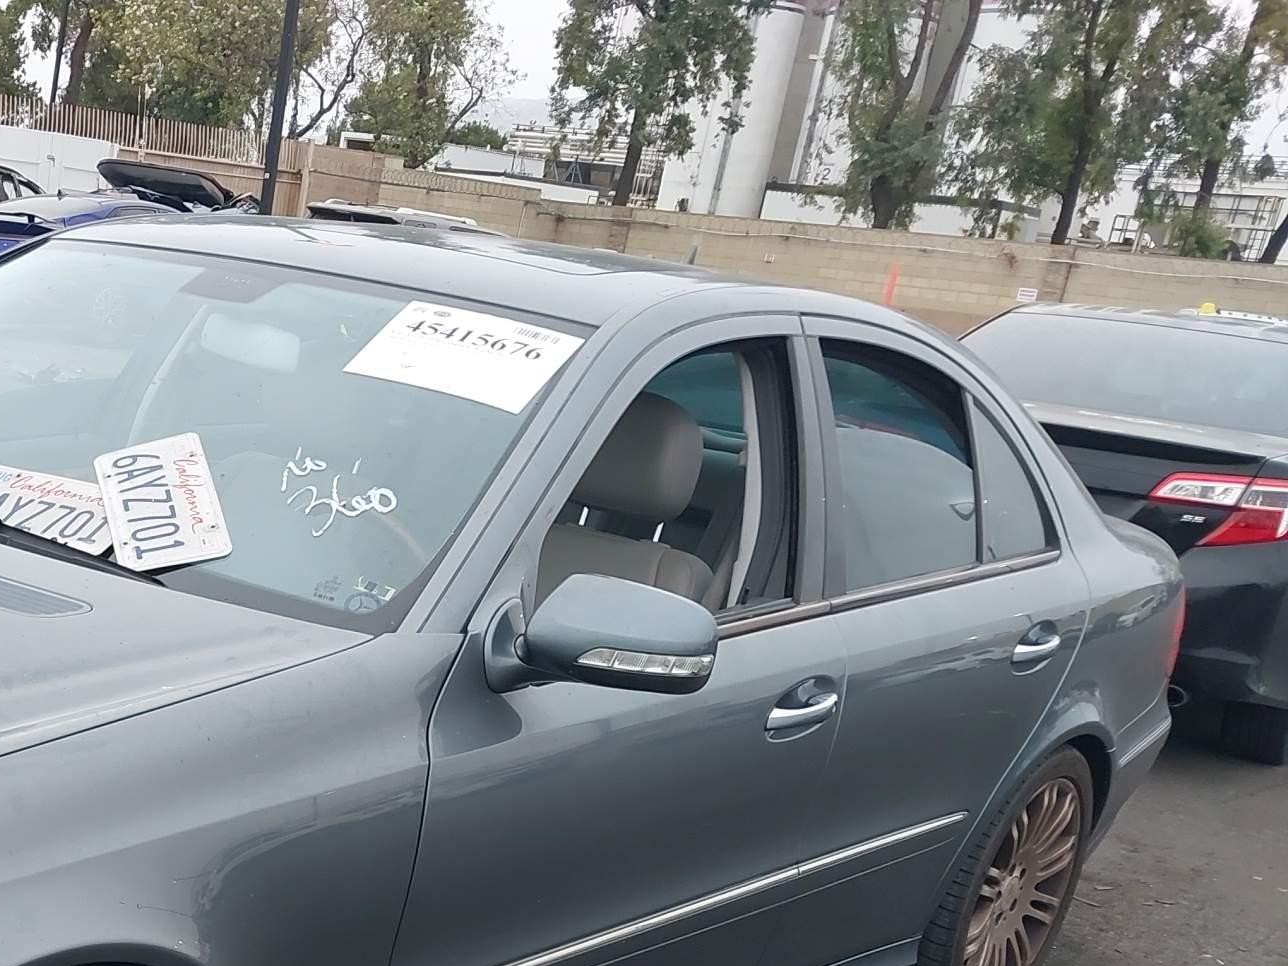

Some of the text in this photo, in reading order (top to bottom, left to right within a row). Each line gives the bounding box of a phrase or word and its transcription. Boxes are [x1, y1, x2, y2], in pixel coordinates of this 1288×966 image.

[405, 319, 542, 361] 45415676
[112, 454, 185, 560] 6AYZ701
[173, 459, 204, 535] California
